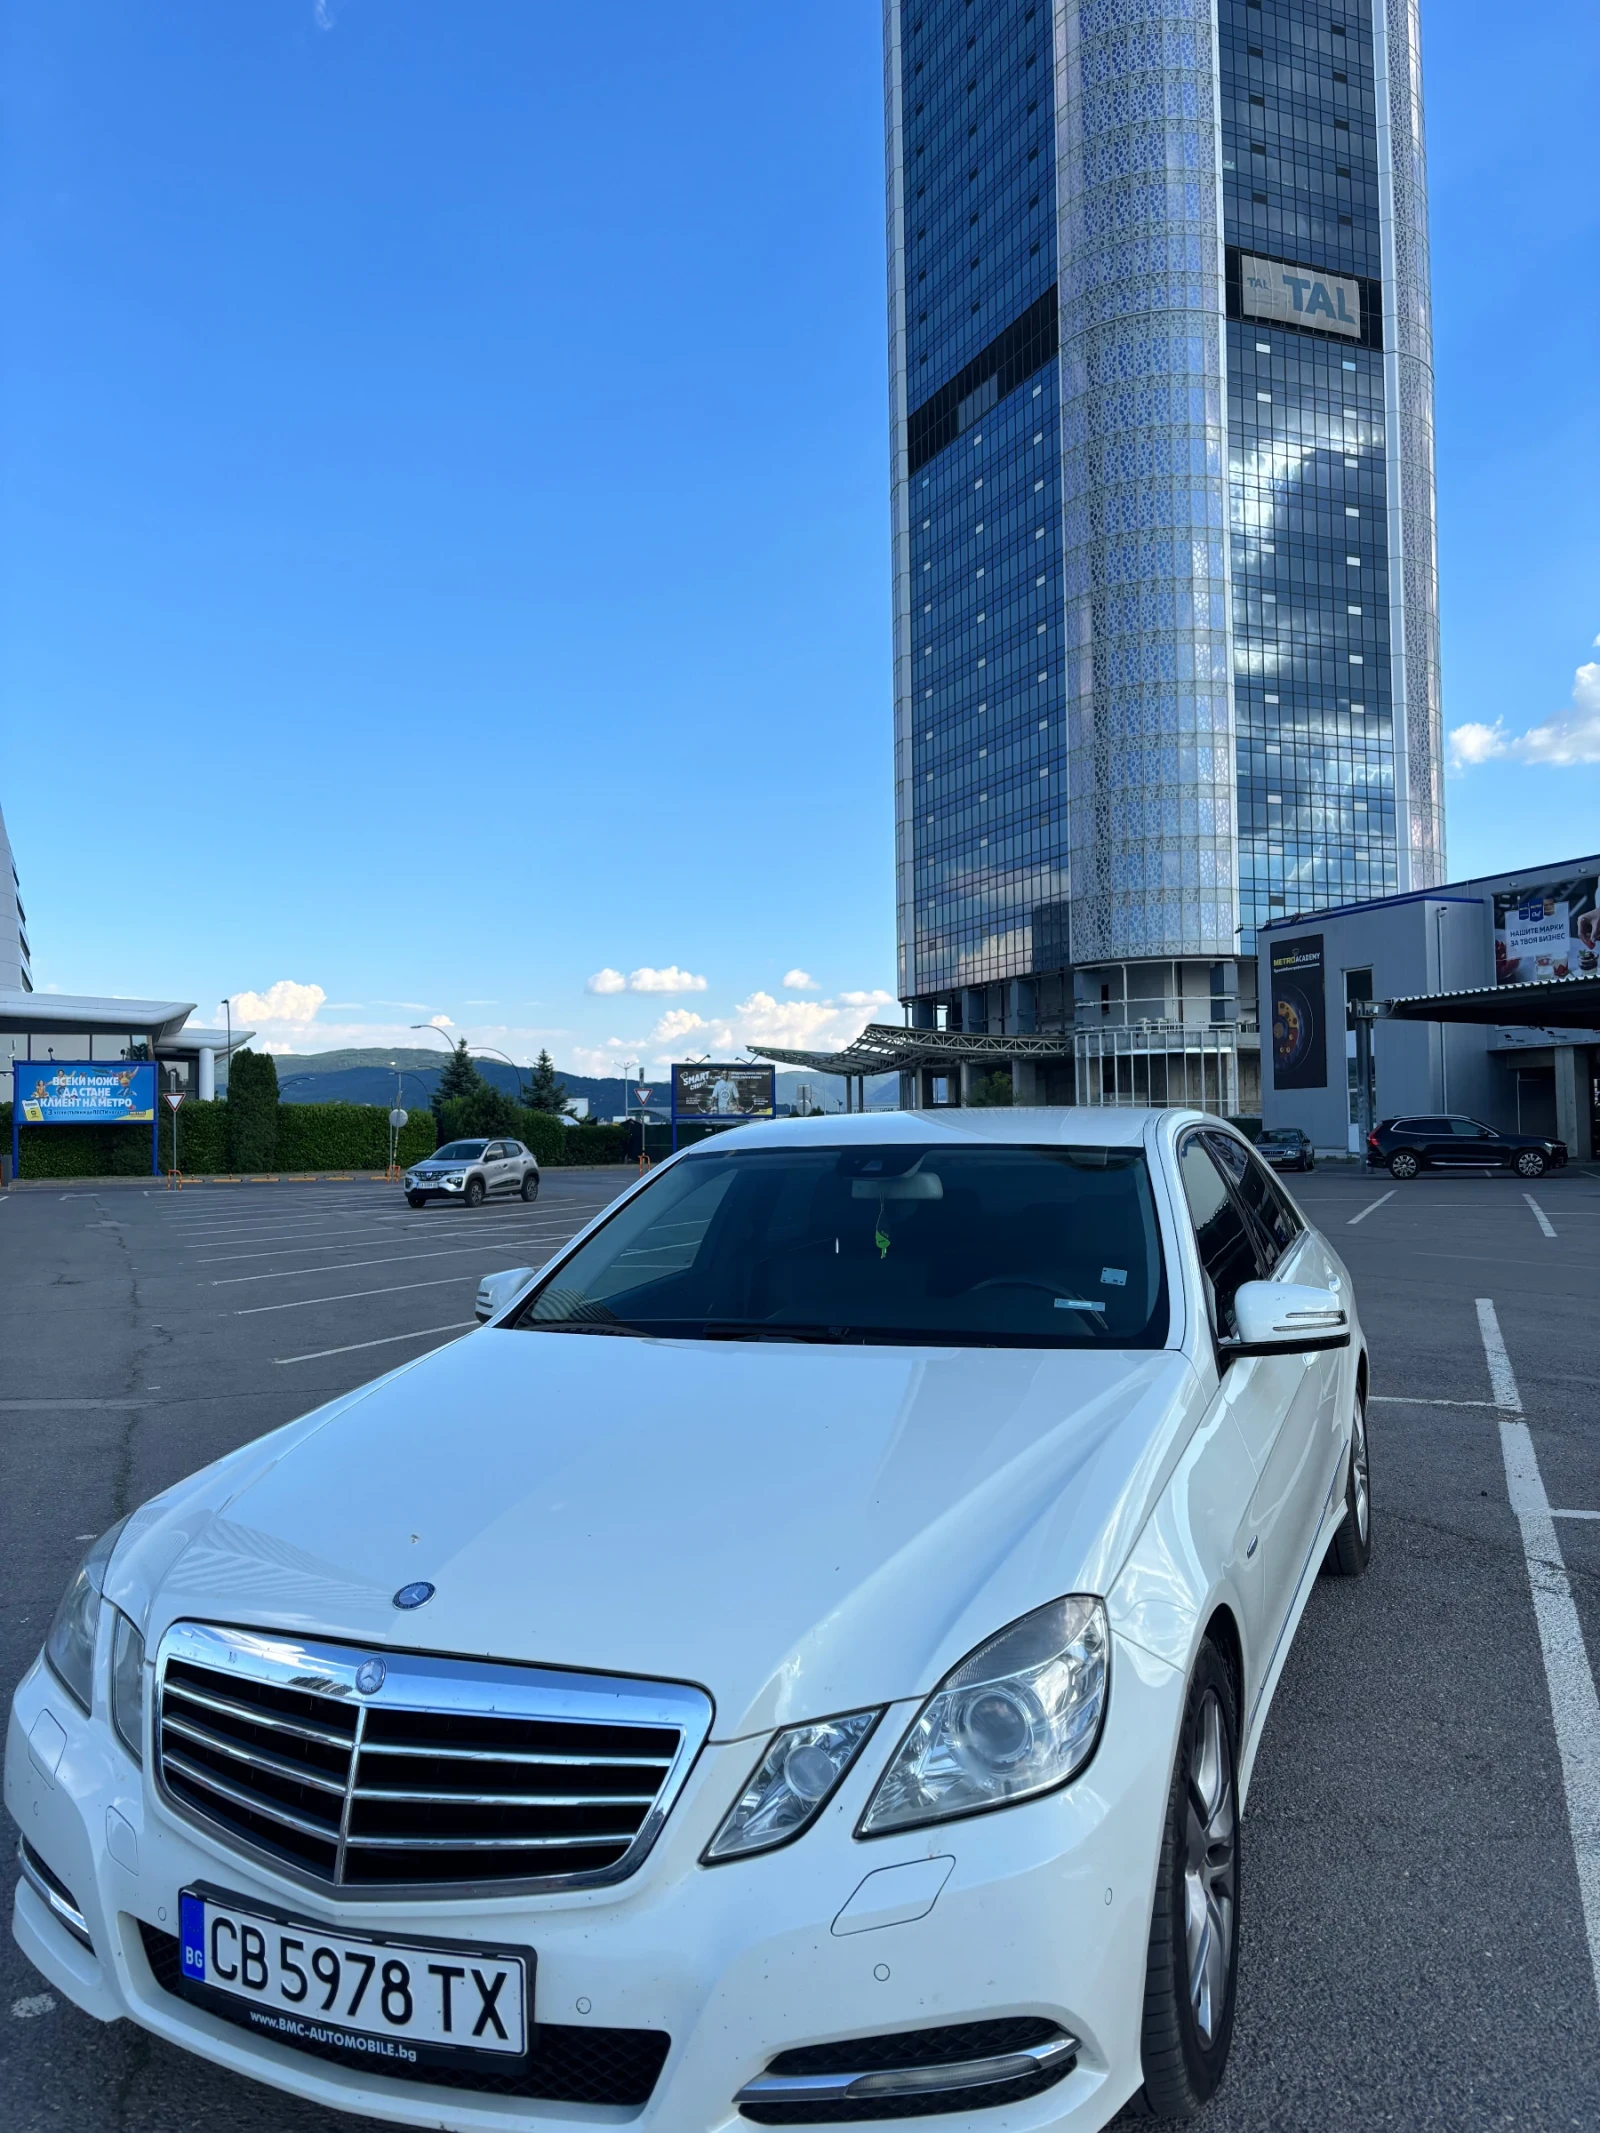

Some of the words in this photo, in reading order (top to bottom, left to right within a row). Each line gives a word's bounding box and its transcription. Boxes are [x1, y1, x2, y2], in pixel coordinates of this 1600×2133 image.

[1246, 276, 1270, 290] TAL
[1282, 274, 1357, 325] TAL
[1510, 927, 1539, 938] НАШИТЕ
[1540, 923, 1564, 933] МАРКИ
[1539, 933, 1565, 942] БИЗНЕС
[52, 1076, 86, 1086] ВСЕКИ
[87, 1076, 119, 1086] МОЖЕ
[683, 1071, 710, 1086] SMART
[62, 1088, 78, 1097] ДА
[79, 1087, 111, 1097] СТАНЕ
[40, 1098, 81, 1108] КЛИЕНТ
[83, 1098, 97, 1108] НА
[98, 1098, 132, 1108] МЕТРО
[185, 1945, 204, 1970] BG
[211, 1915, 269, 1992] CB
[280, 1935, 414, 2026] 5978
[427, 1963, 509, 2041] TX
[249, 2010, 418, 2064] www.BMC-AUTOMOBILE.bg
